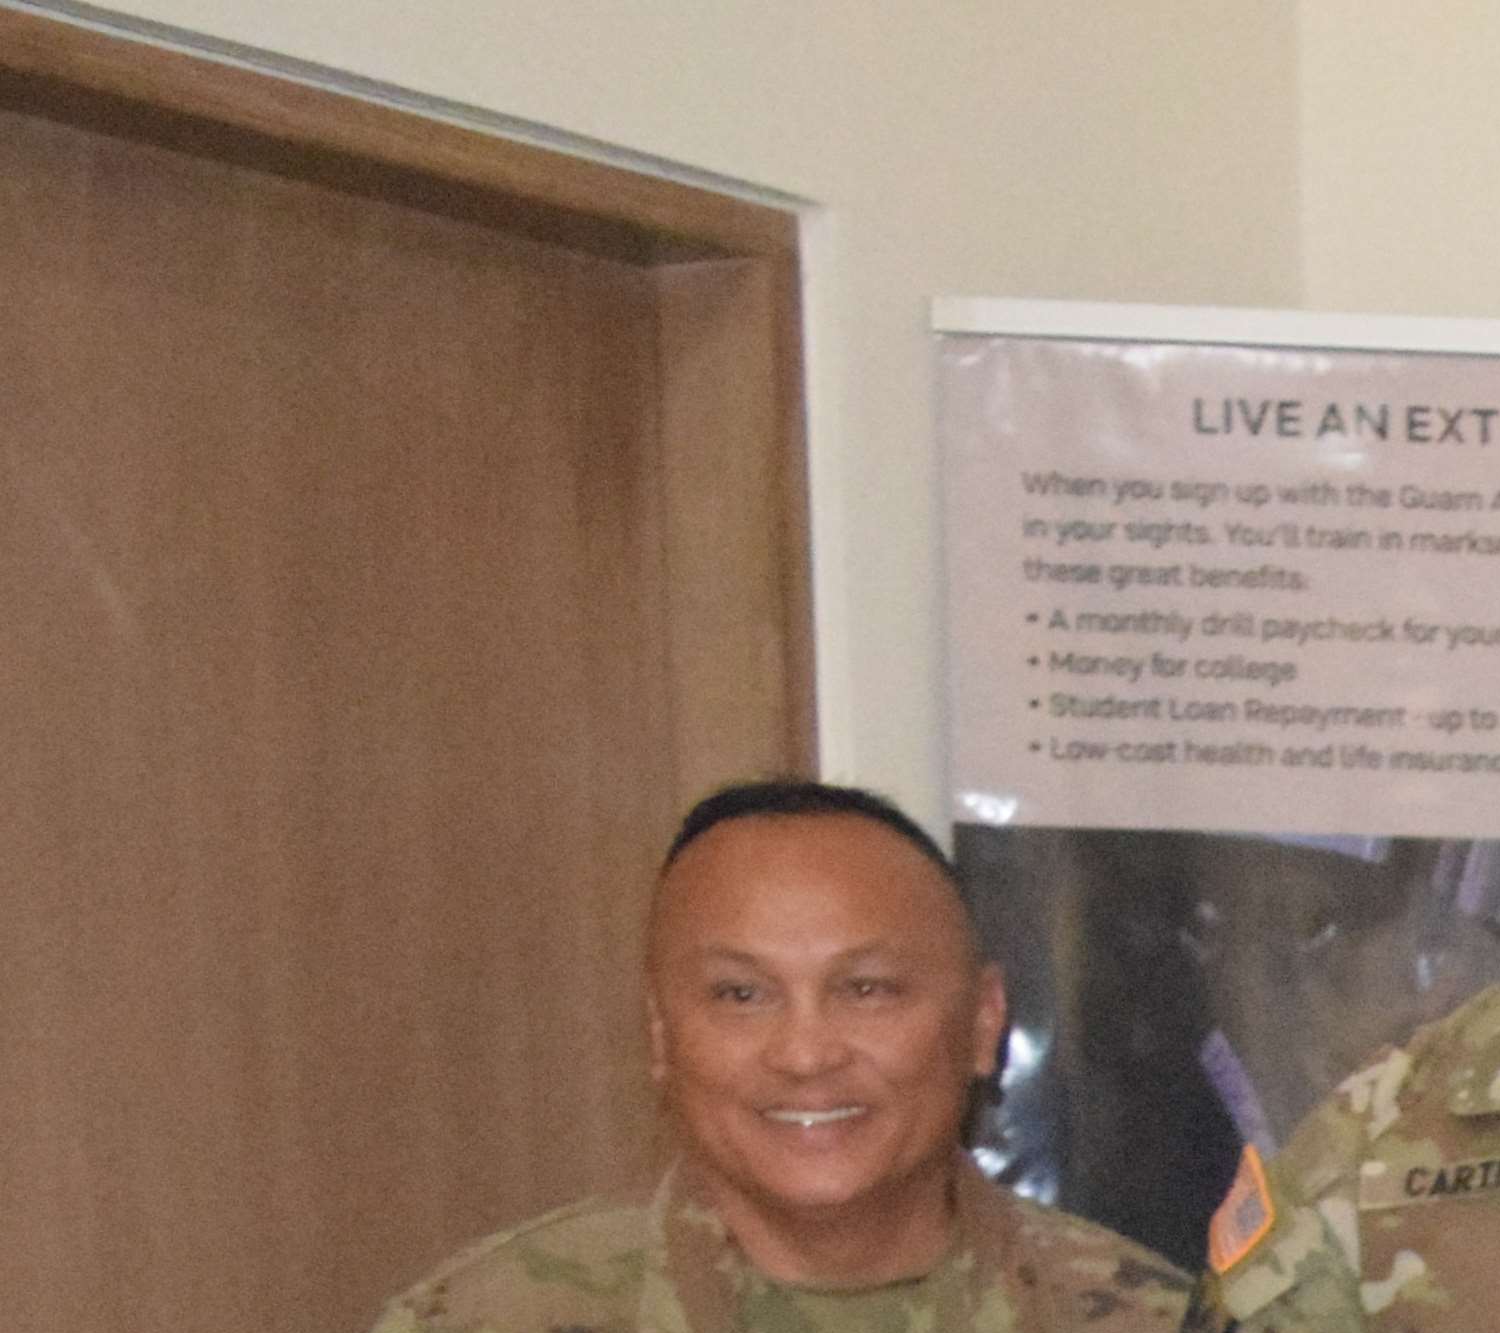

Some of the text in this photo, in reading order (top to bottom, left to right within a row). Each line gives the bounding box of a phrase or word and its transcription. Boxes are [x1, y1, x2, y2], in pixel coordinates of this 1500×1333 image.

[1193, 398, 1303, 438] LIVE
[1316, 403, 1390, 442] AN
[1022, 471, 1102, 496] When
[1113, 479, 1163, 505] you
[1170, 479, 1229, 507] sign
[1236, 483, 1271, 506] up
[1278, 480, 1338, 504] with
[1346, 480, 1391, 508] the
[1399, 485, 1482, 512] Guam
[1022, 520, 1049, 540] in
[1055, 522, 1113, 548] your
[1306, 528, 1372, 552] train
[1379, 532, 1403, 553] in
[1022, 557, 1101, 583] these
[1107, 562, 1181, 590] great
[1048, 609, 1070, 631] A
[1076, 612, 1193, 642] monthly
[1201, 616, 1254, 639] drill
[1261, 619, 1394, 647] paycheck
[1404, 621, 1440, 645] for
[1049, 652, 1297, 685] Money for college
[1049, 694, 1161, 720] Student
[1169, 699, 1236, 722] Loan
[1244, 700, 1406, 731] Repayment
[1430, 709, 1463, 733] up
[1470, 708, 1498, 731] to
[1049, 737, 1177, 763] Low-cost
[1184, 739, 1274, 766] health
[1281, 742, 1333, 769] and
[1339, 744, 1383, 769] life
